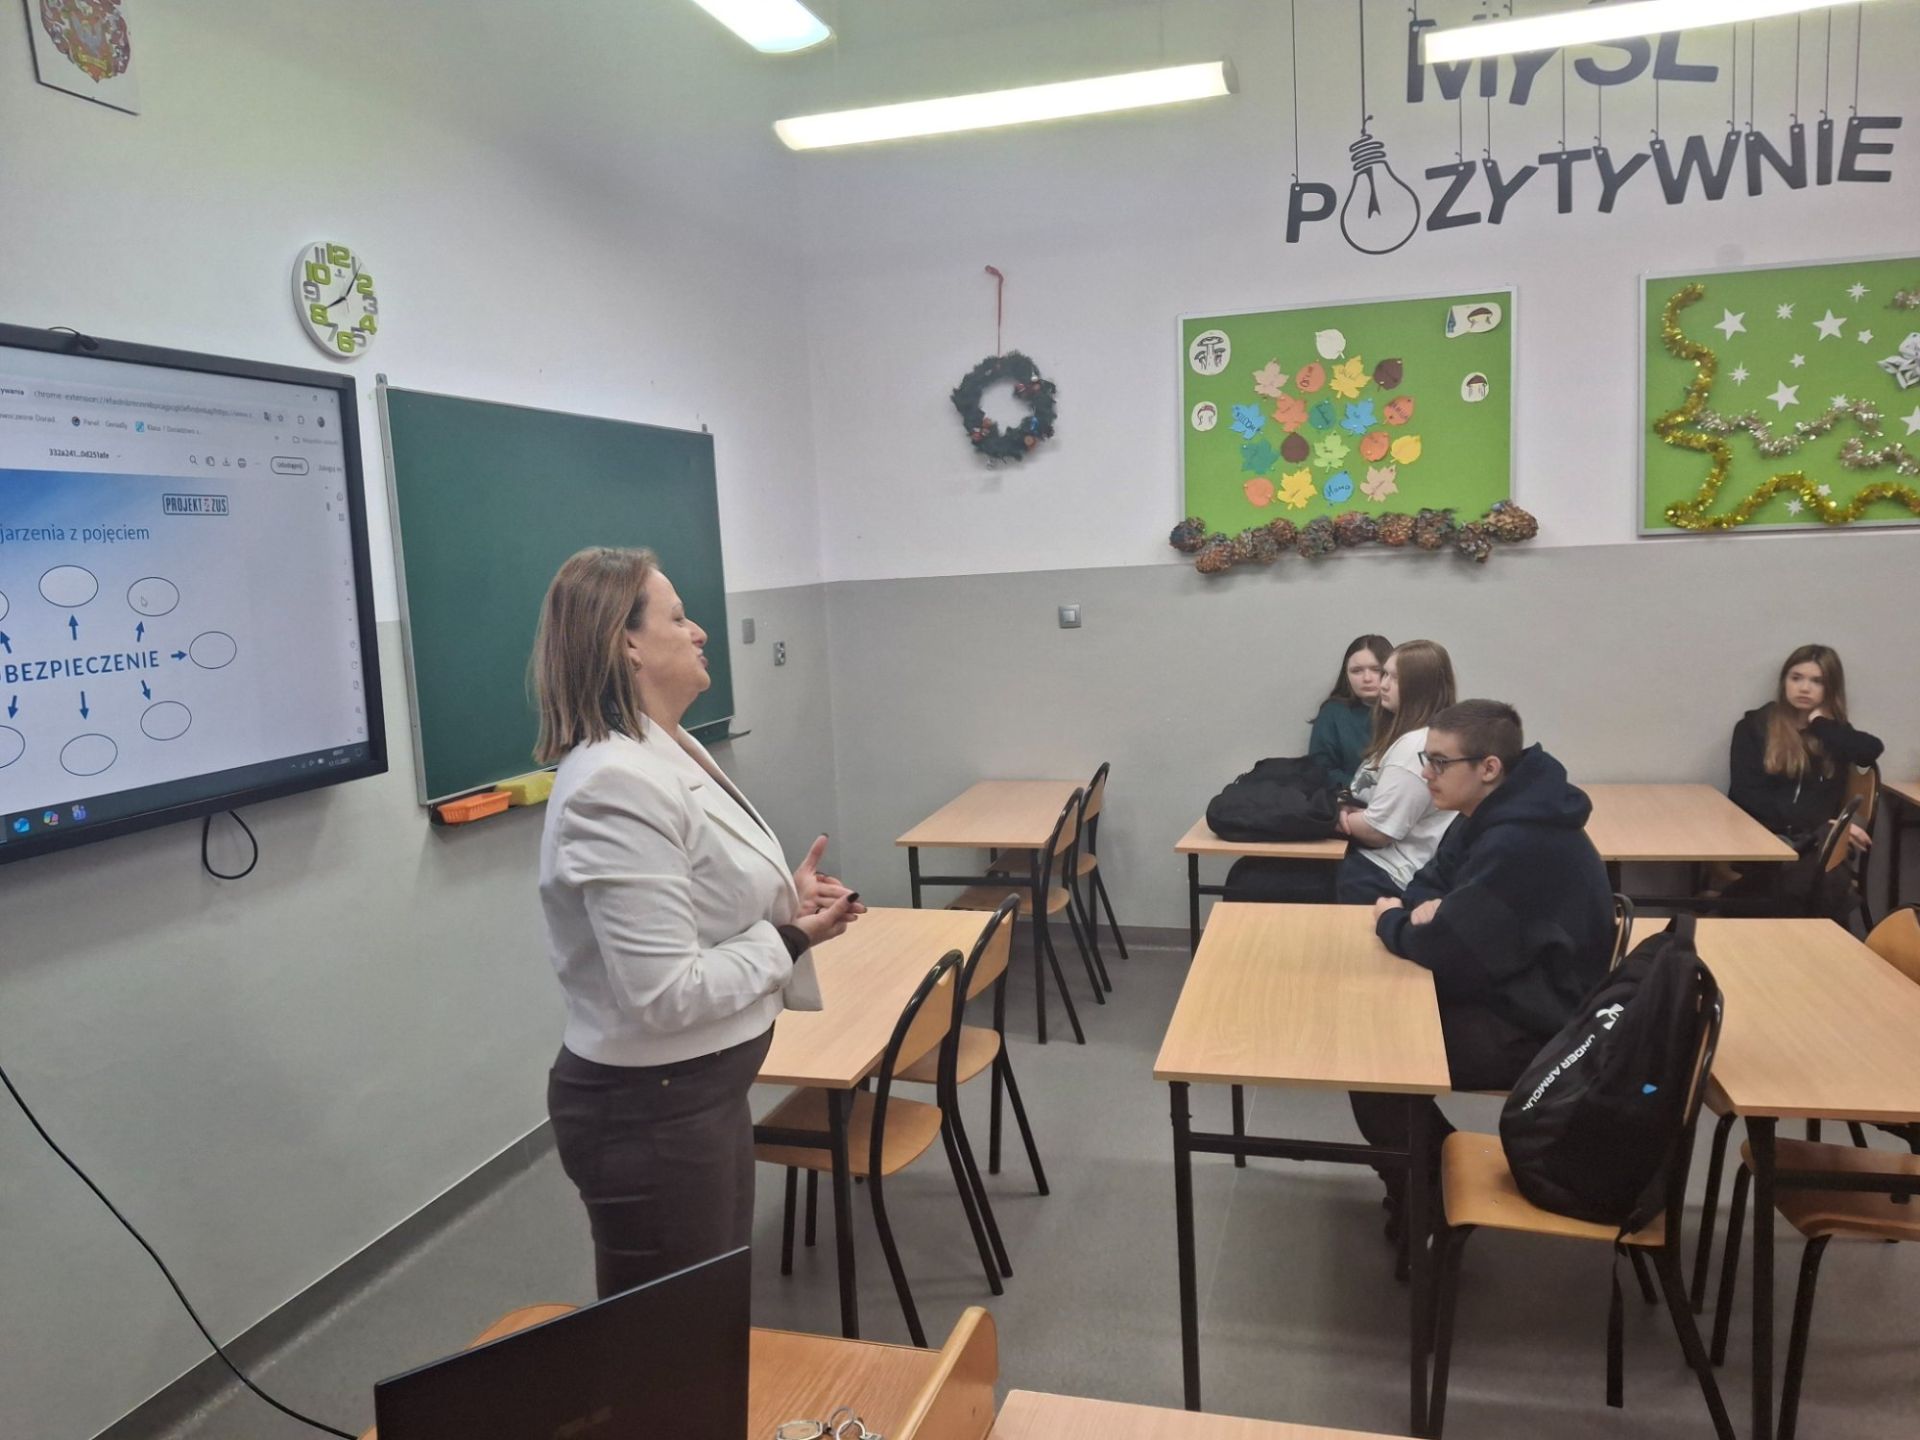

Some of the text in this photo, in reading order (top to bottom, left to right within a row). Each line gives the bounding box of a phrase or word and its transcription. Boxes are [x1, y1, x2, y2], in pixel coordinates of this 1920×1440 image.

[314, 246, 326, 264] 11
[326, 243, 351, 269] 12
[305, 260, 331, 286] 10
[303, 280, 320, 302] 9
[356, 273, 374, 296] 2
[310, 303, 329, 325] 8
[362, 295, 378, 315] 3
[324, 322, 339, 342] 7
[359, 314, 377, 335] 4
[337, 331, 355, 353] 6
[350, 326, 367, 347] 5
[165, 497, 202, 513] PROJEKT
[211, 498, 227, 513] ZUS
[70, 527, 78, 541] z
[82, 523, 150, 545] pojęciem
[0, 650, 160, 683] BEZPIECZENIE
[1560, 1033, 1596, 1069] UNDER
